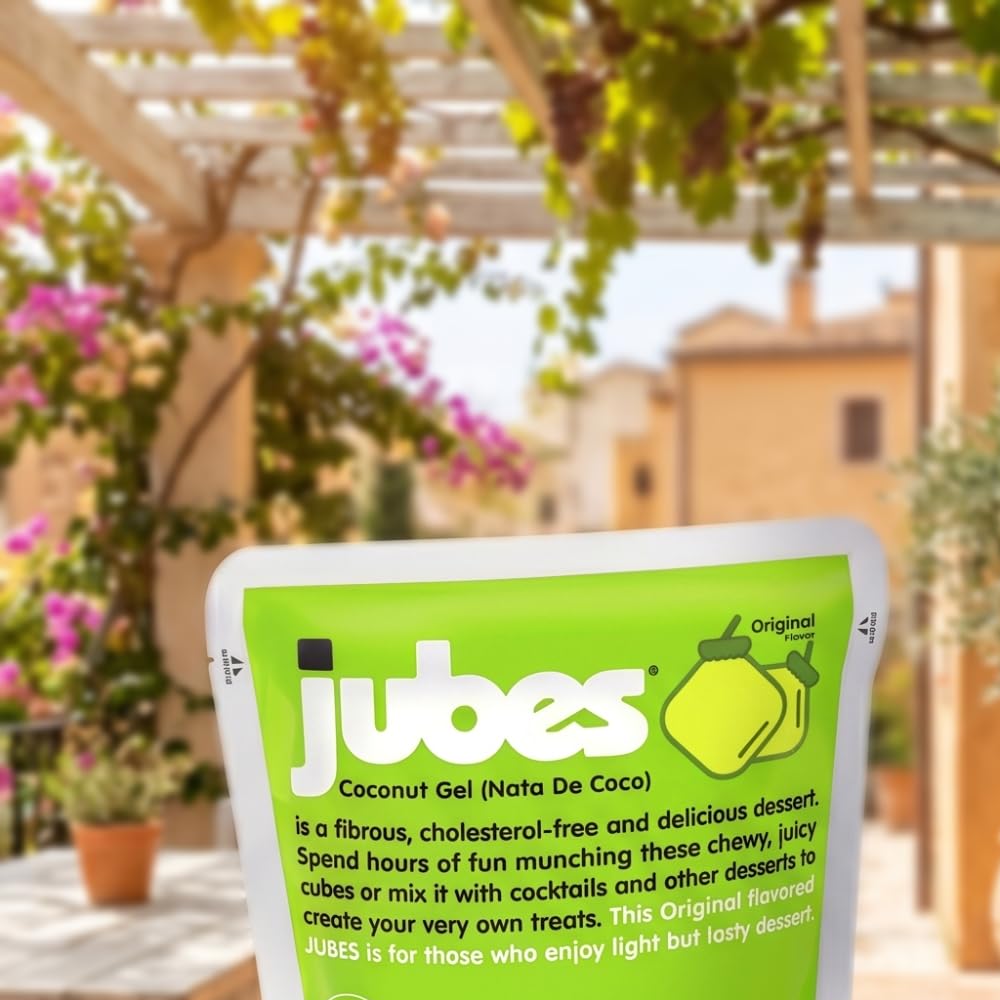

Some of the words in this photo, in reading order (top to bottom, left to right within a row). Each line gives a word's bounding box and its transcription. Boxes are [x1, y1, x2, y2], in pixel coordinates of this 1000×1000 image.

[751, 613, 815, 635] Original
[291, 638, 648, 797] jubes
[339, 779, 429, 799] Coconut
[435, 779, 473, 800] Gel
[481, 779, 544, 802] (Nata
[553, 777, 583, 795] De
[590, 771, 651, 793] Coco)
[295, 816, 310, 836] is
[315, 822, 328, 838] a
[333, 818, 412, 846] fibrous,
[419, 818, 599, 842] cholesterol-free
[606, 812, 649, 835] and
[657, 804, 748, 830] delicious
[753, 788, 819, 818] dessert.
[297, 846, 359, 872] Spend
[367, 851, 429, 874] hours
[437, 852, 461, 873] of
[468, 852, 507, 873] fun
[516, 847, 632, 871] munching
[640, 841, 701, 863] these
[707, 831, 772, 854] chewy,
[778, 820, 817, 850] juicy
[300, 877, 355, 900] cubes
[360, 886, 382, 902] or
[388, 883, 427, 903] mix
[434, 883, 449, 903] it
[454, 882, 502, 903] with
[510, 877, 608, 902] cocktails
[614, 872, 657, 895] and
[664, 867, 719, 890] other
[724, 852, 796, 882] desserts
[800, 848, 816, 866] to
[303, 910, 363, 931] create
[368, 917, 417, 937] your
[422, 919, 469, 940] very
[476, 918, 523, 934] own
[530, 910, 602, 932] treats.
[608, 903, 654, 926] This
[659, 891, 742, 922] Original
[747, 875, 815, 908] flavored
[305, 936, 361, 961] JUBES
[365, 942, 383, 963] is
[387, 943, 418, 965] for
[423, 944, 484, 966] those
[490, 943, 538, 965] who
[543, 939, 606, 966] enjoy
[611, 933, 661, 961] light
[666, 928, 701, 951] but
[755, 905, 815, 936] dessert.
